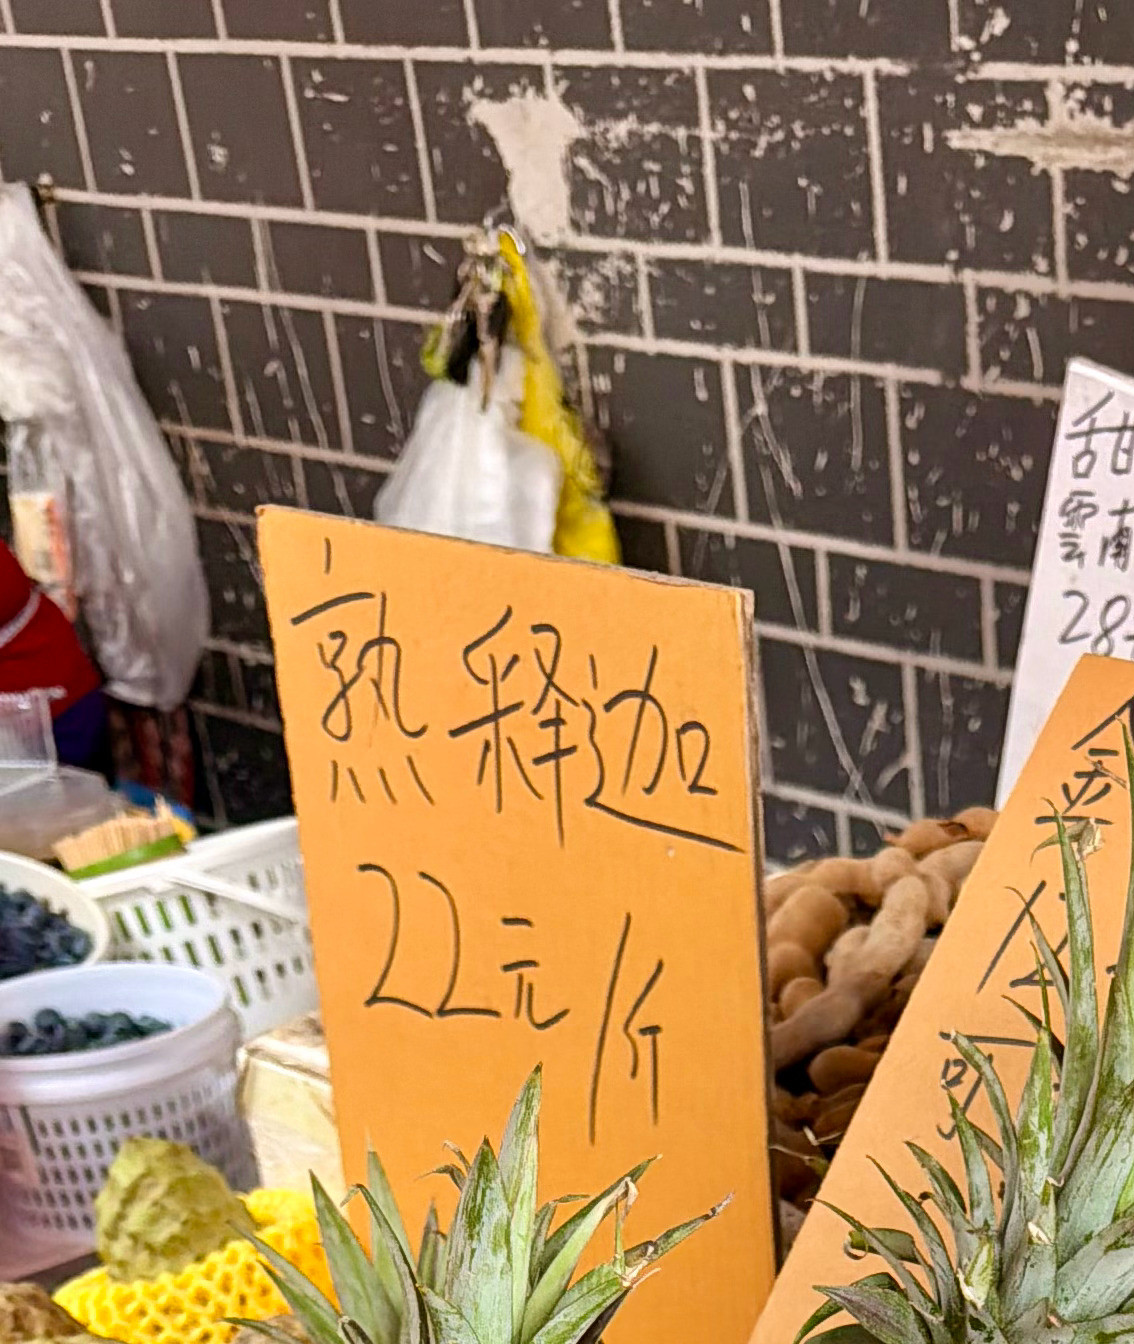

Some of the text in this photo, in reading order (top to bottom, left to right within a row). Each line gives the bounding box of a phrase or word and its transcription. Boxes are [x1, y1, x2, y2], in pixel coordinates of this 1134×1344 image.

[290, 537, 746, 850] 熟释迦
[357, 862, 664, 1146] 22元/斤
